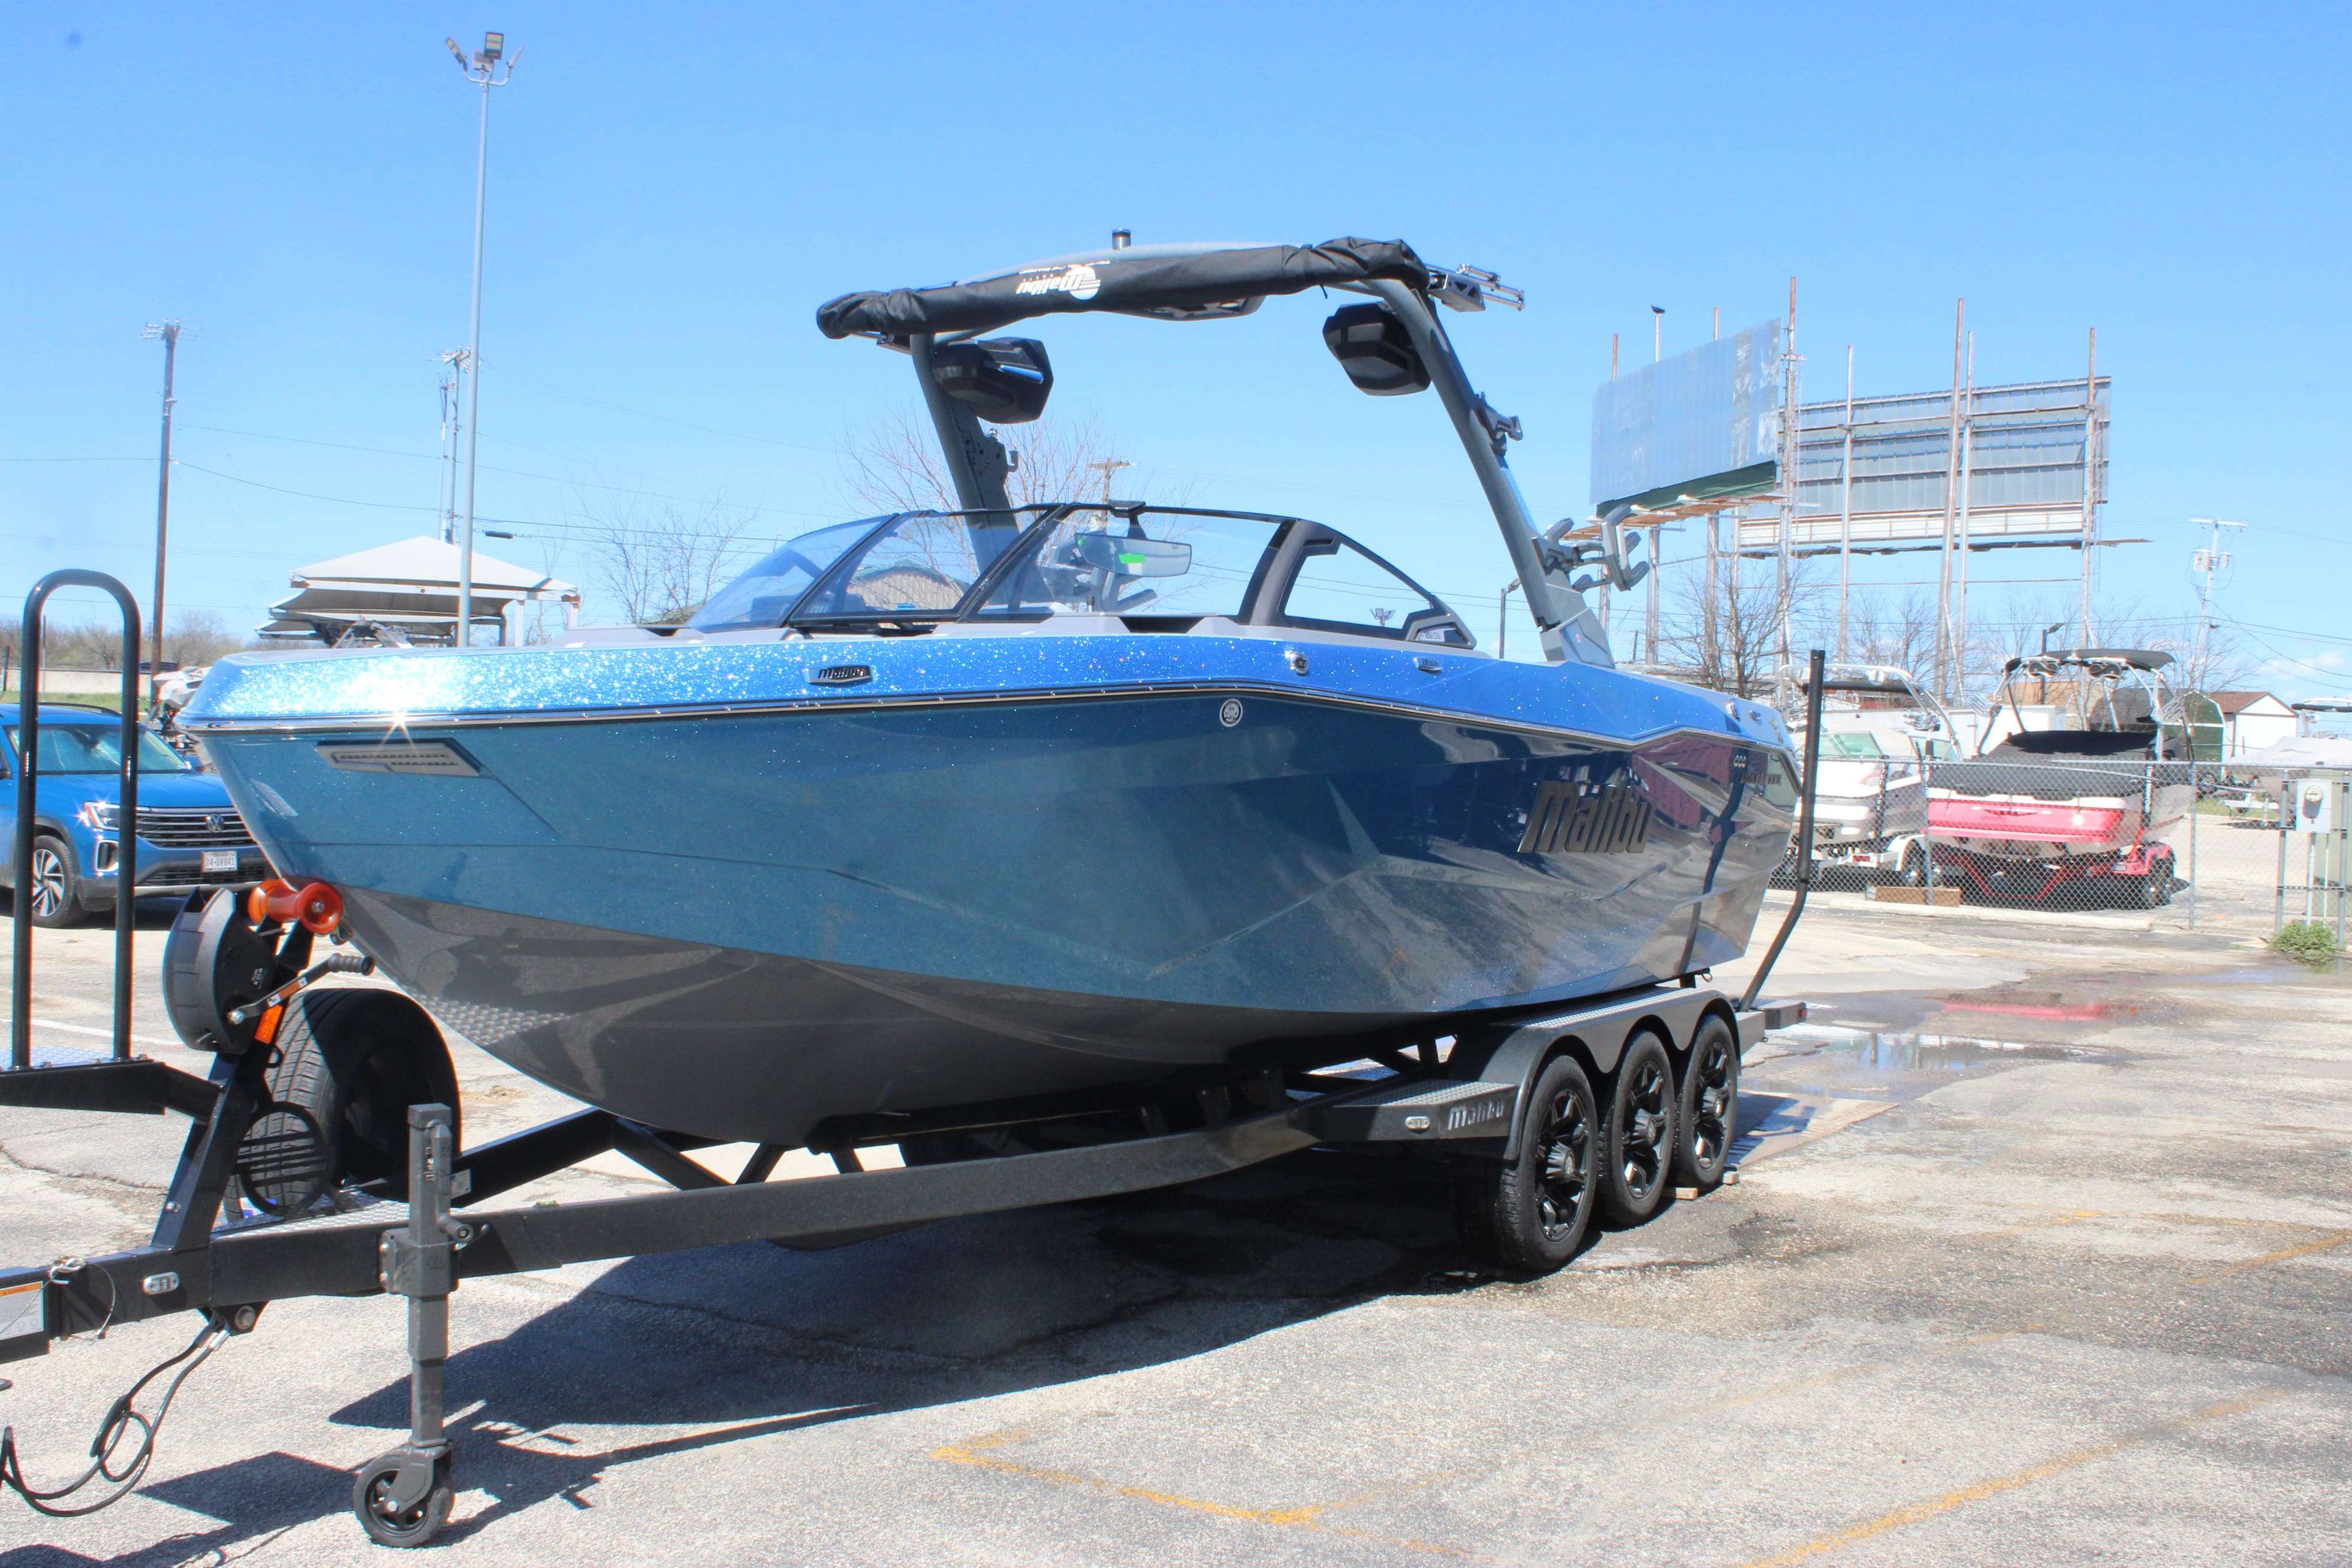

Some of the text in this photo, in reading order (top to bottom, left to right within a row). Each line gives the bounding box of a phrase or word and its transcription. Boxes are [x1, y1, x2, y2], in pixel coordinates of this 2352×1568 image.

[1016, 275, 1083, 295] Malibu
[1517, 780, 1652, 853] Malibu
[1448, 1099, 1505, 1131] Malibu
